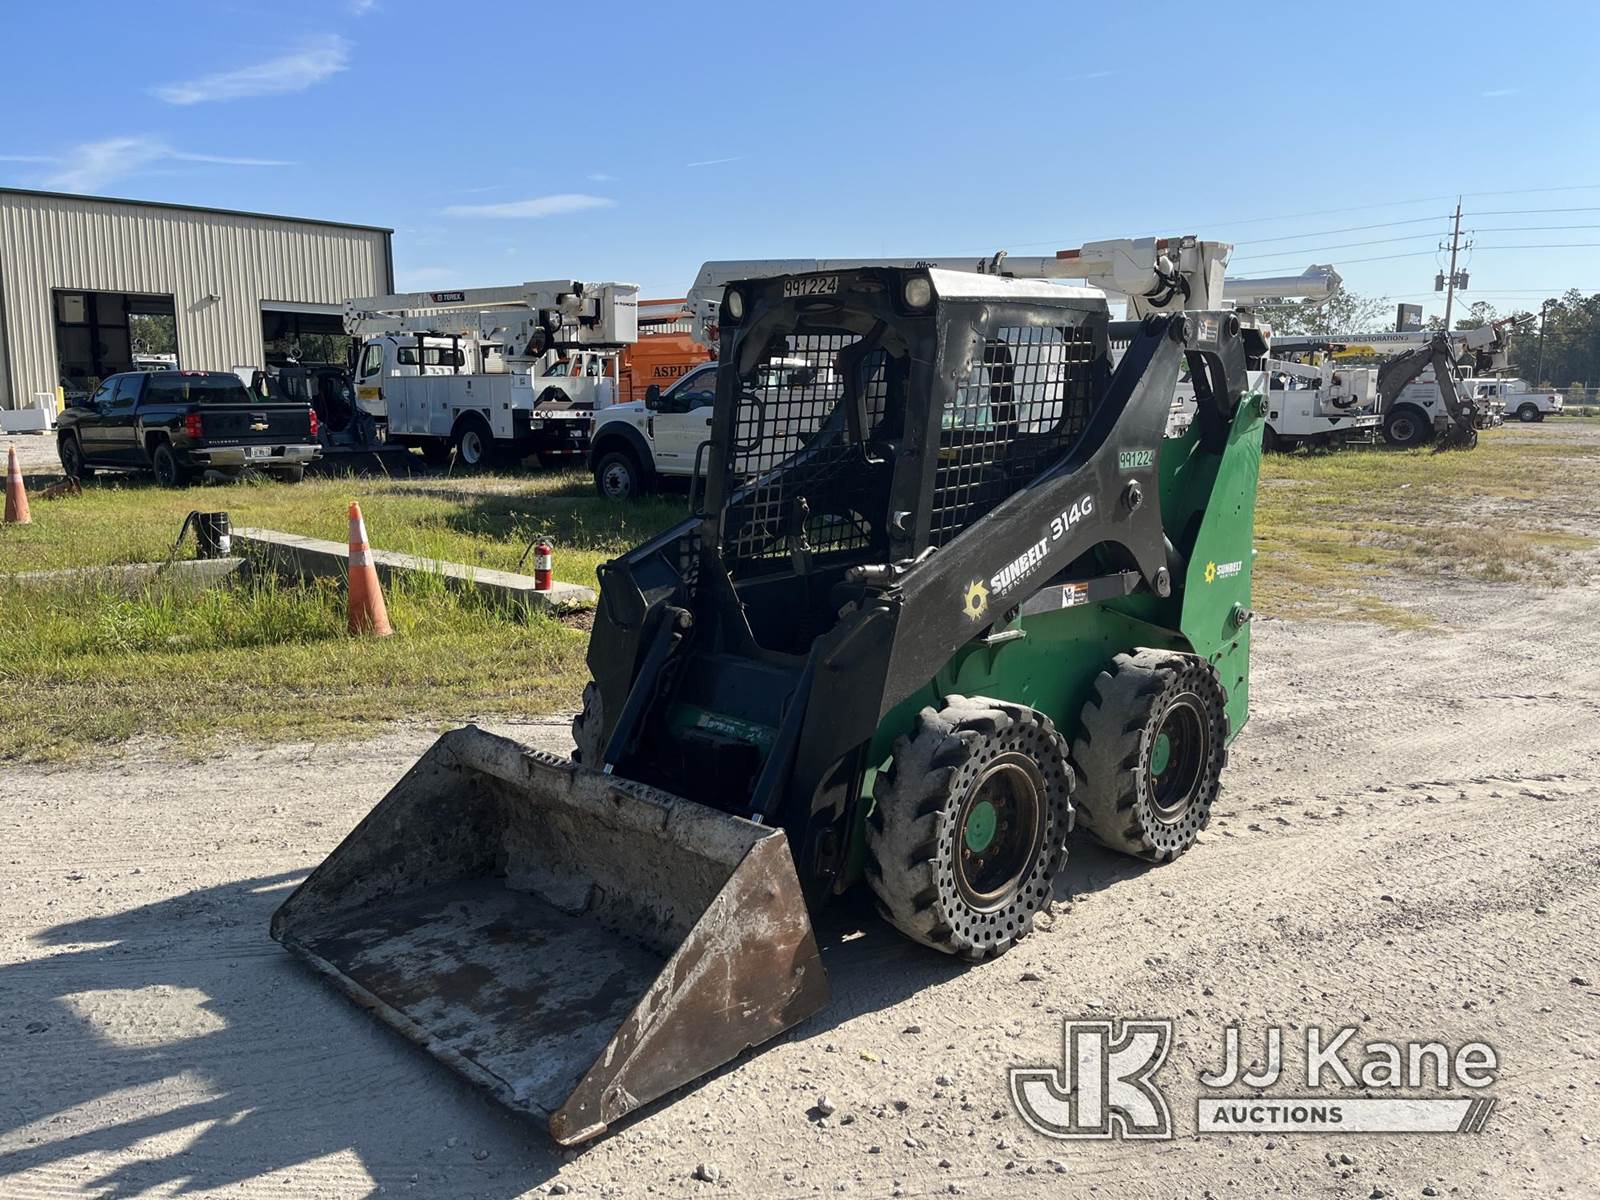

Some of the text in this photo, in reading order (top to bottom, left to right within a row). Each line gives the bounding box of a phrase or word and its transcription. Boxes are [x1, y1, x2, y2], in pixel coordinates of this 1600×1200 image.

[785, 277, 836, 297] 991224
[1121, 451, 1153, 467] 991224
[1050, 496, 1093, 541] 314G
[990, 537, 1048, 596] SUNBELT
[1001, 560, 1043, 597] RENTALS
[1216, 560, 1243, 575] SUNBELT
